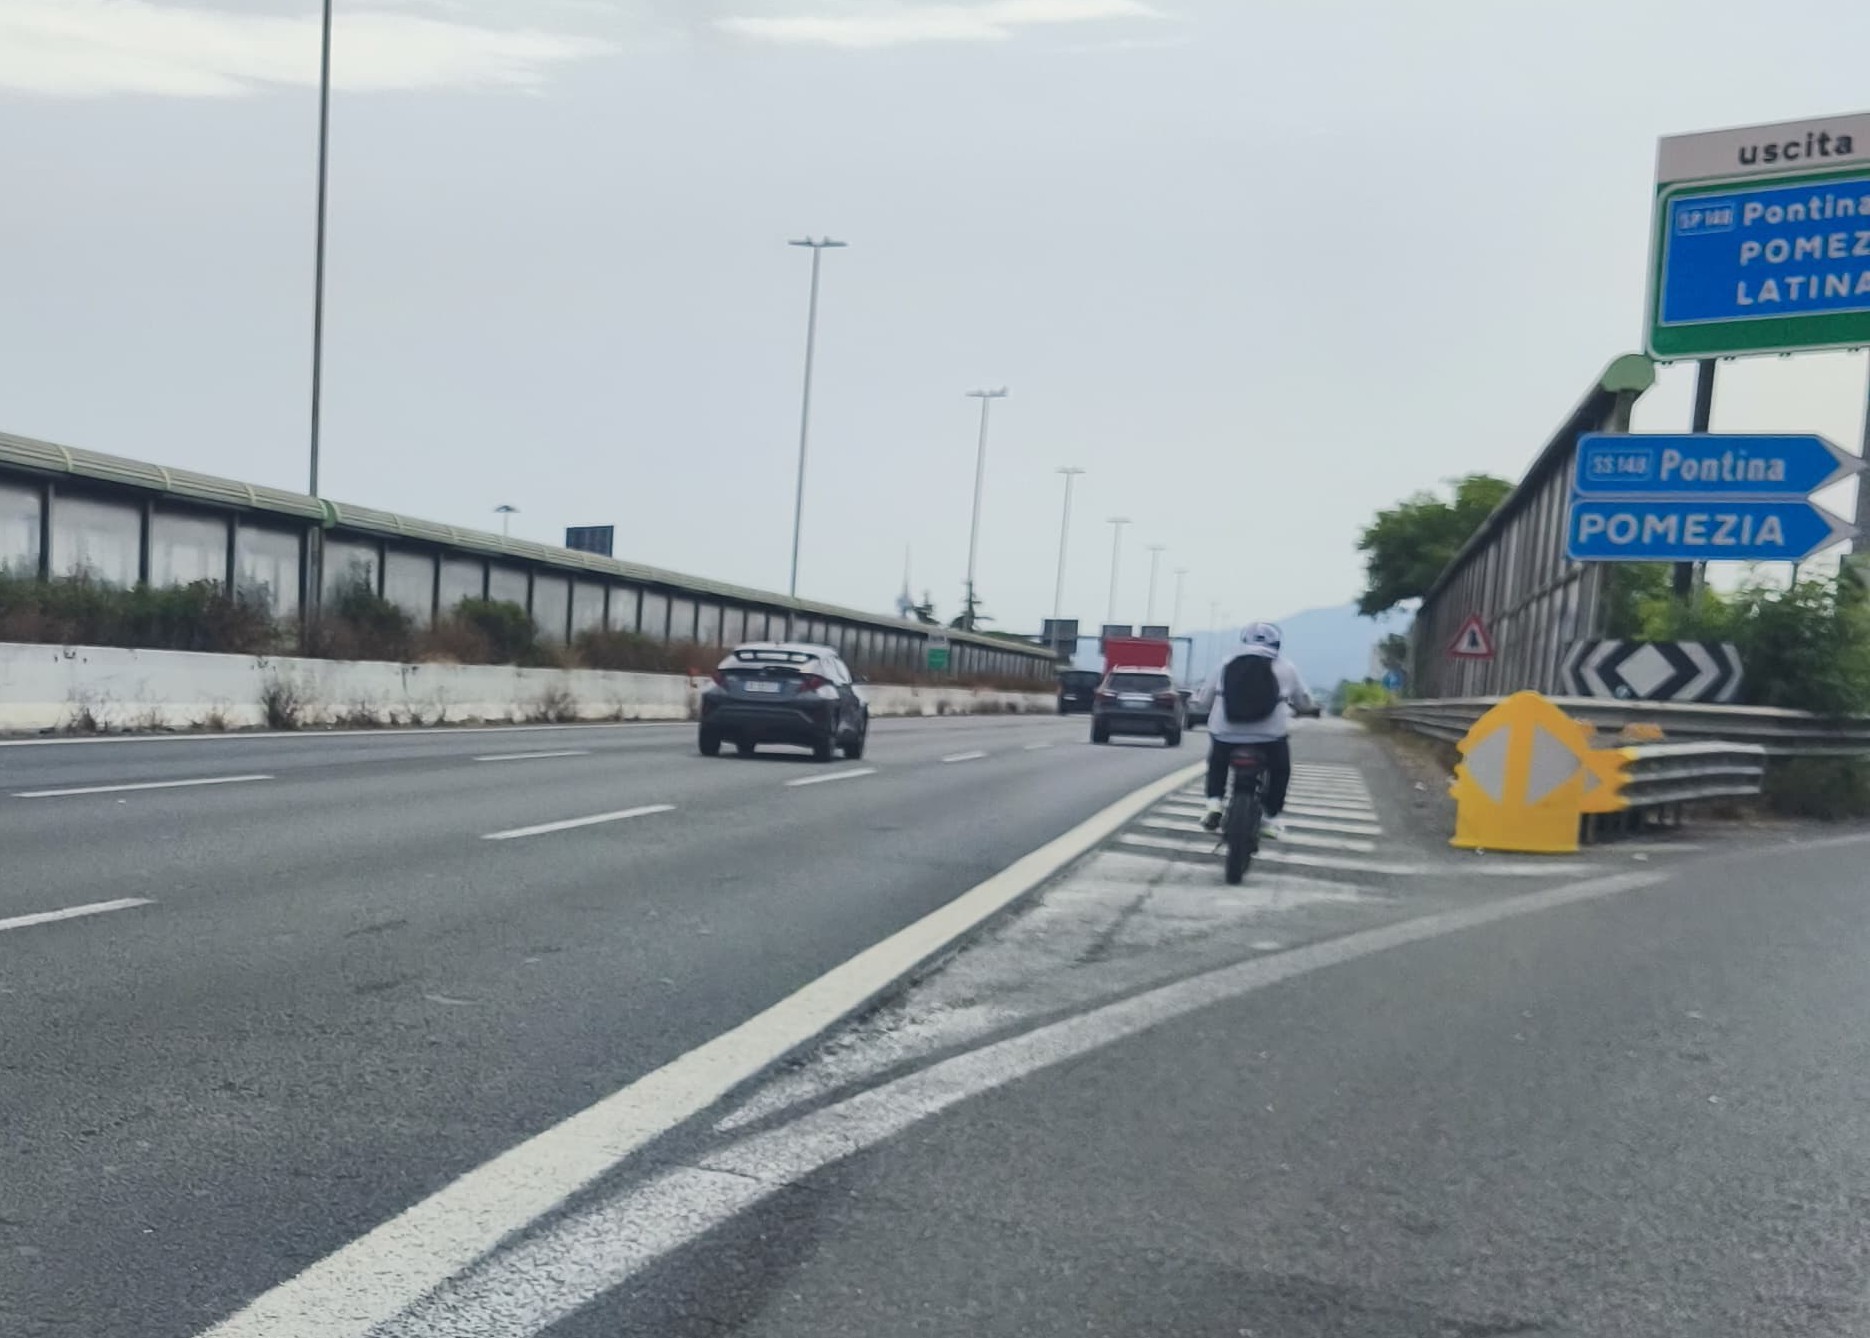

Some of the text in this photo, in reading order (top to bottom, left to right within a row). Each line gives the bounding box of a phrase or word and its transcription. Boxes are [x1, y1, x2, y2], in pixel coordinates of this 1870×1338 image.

[1738, 132, 1853, 165] uscita
[1743, 195, 1870, 226] Pontina
[1736, 272, 1870, 305] LATINA
[1660, 449, 1785, 481] Pontina
[1578, 514, 1784, 545] POMEZIA
